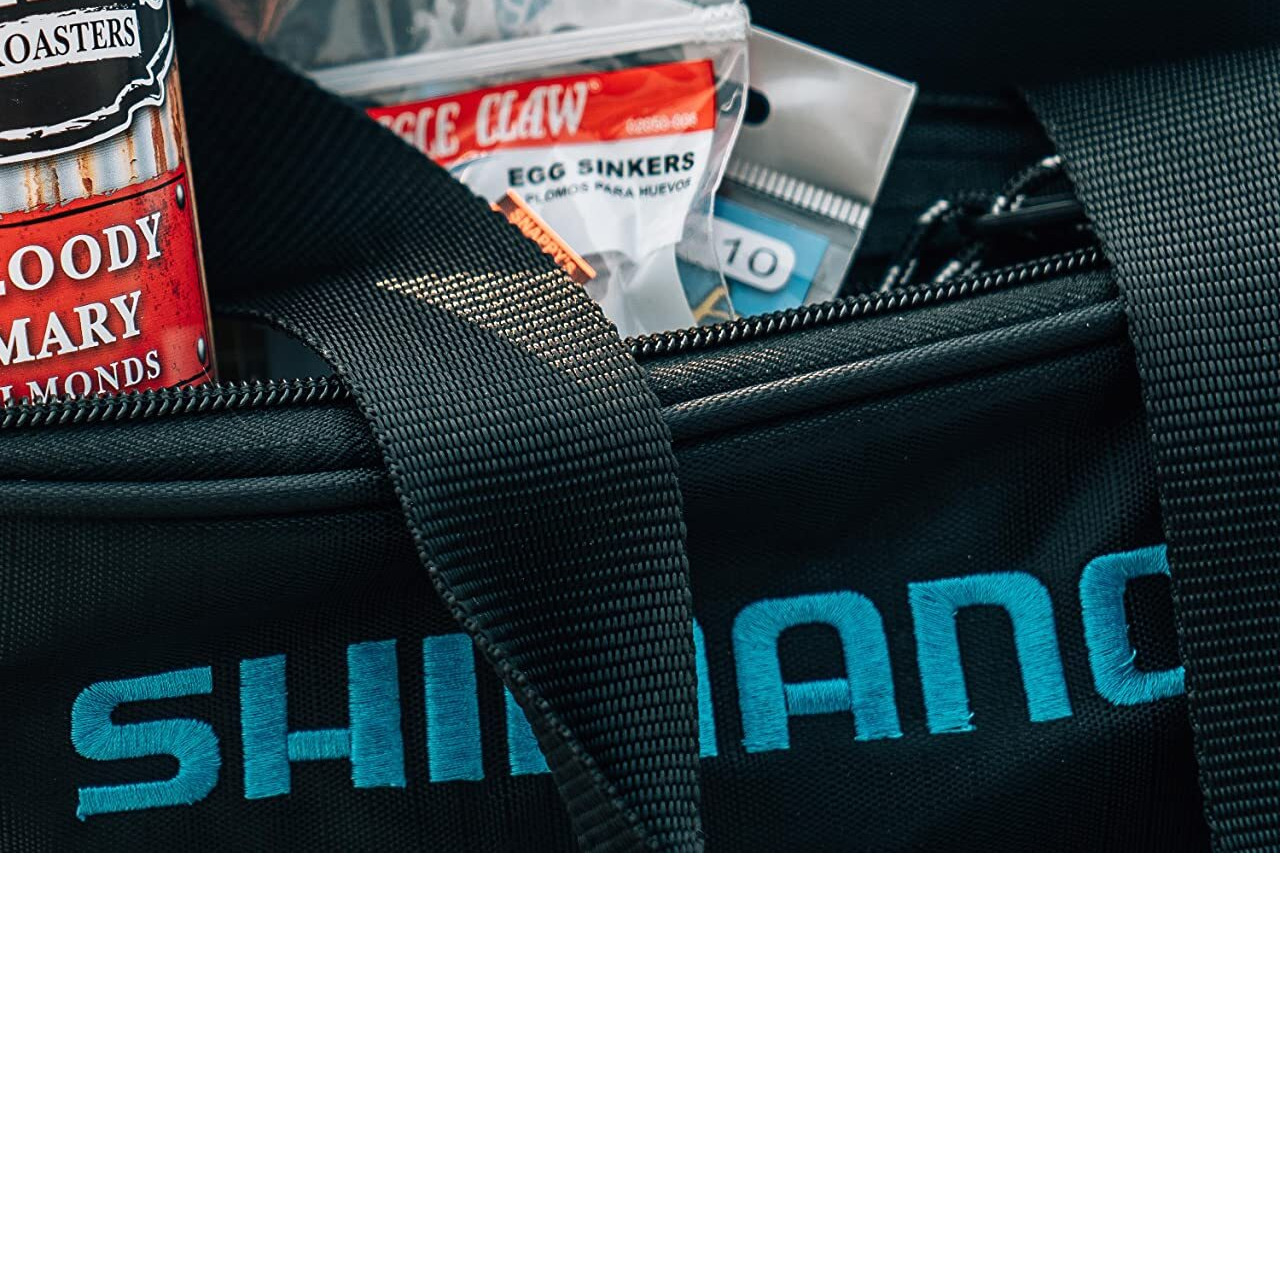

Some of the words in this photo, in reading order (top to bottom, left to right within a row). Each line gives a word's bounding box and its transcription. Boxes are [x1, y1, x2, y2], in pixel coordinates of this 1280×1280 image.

[376, 101, 462, 158] GLE
[475, 81, 589, 147] CLAW
[507, 161, 566, 188] EGG
[578, 151, 695, 179] SINKERS
[525, 181, 589, 204] PLOMOS
[595, 180, 634, 199] PARA
[723, 237, 778, 278] 10
[71, 543, 1187, 821] SHIANO
